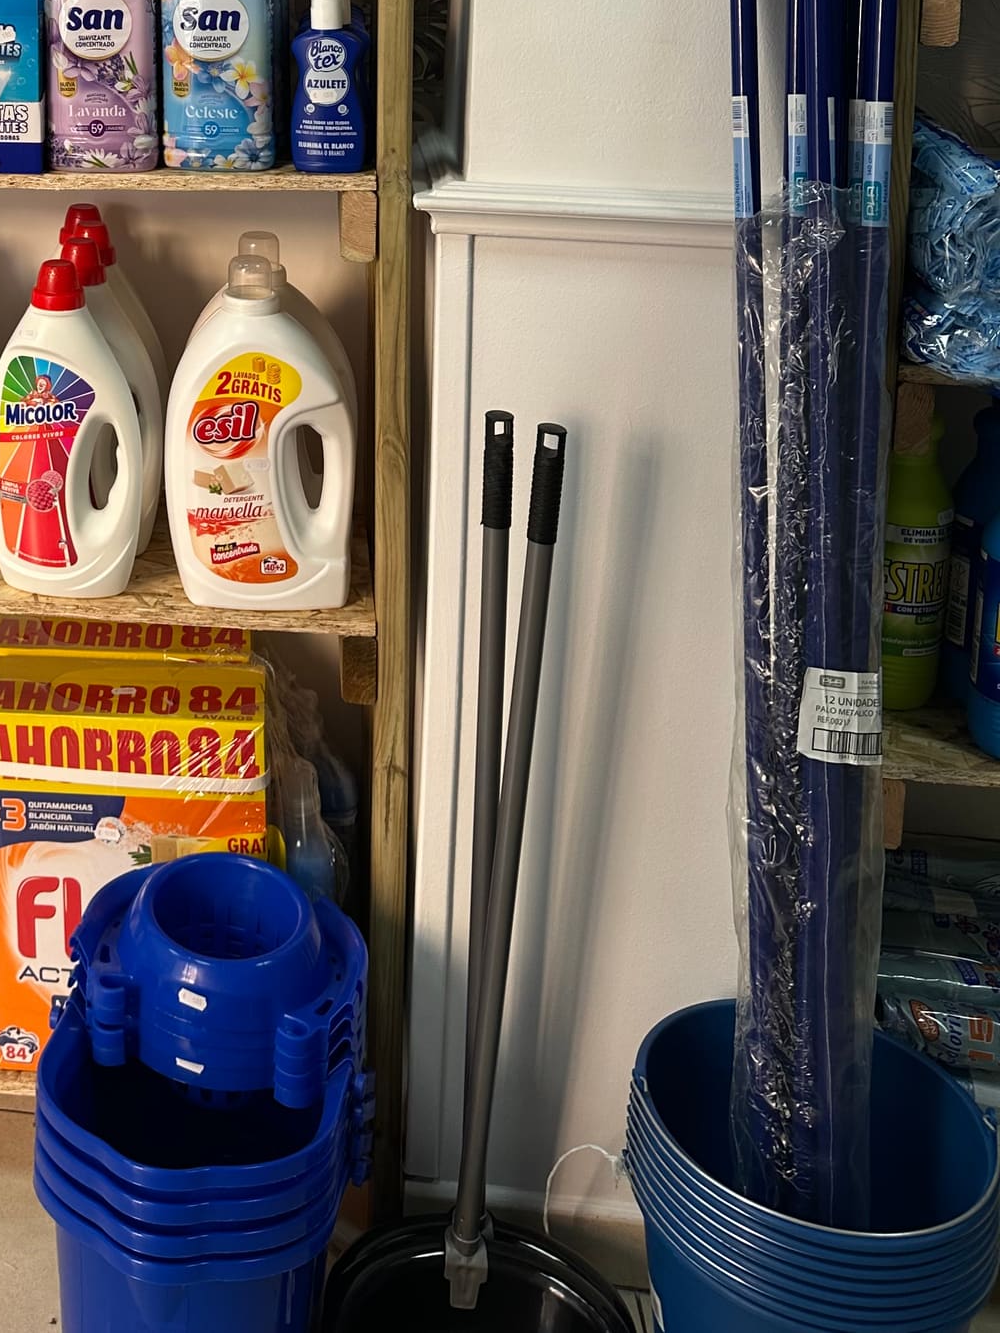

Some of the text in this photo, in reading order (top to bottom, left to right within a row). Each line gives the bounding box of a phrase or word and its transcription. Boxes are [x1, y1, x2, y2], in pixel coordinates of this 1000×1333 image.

[307, 79, 347, 89] AZULETE
[68, 104, 126, 117] Lavanda
[185, 106, 238, 119] Celeste
[91, 124, 103, 134] 59
[205, 125, 216, 135] 59
[234, 371, 259, 381] LAVADOS
[215, 371, 232, 395] 2
[231, 379, 282, 403] GRATIS
[195, 403, 256, 442] esil
[224, 494, 264, 503] DETERGENTE
[194, 503, 263, 520] marsella
[901, 529, 938, 537] ELIMINA
[188, 685, 260, 715] 84
[824, 696, 835, 704] 12
[816, 705, 836, 714] PALO
[185, 727, 260, 780] 84
[28, 801, 93, 811] QUITAMANCHAS
[28, 812, 72, 822] BLANCURA
[29, 822, 95, 834] JABÓN NATURAL
